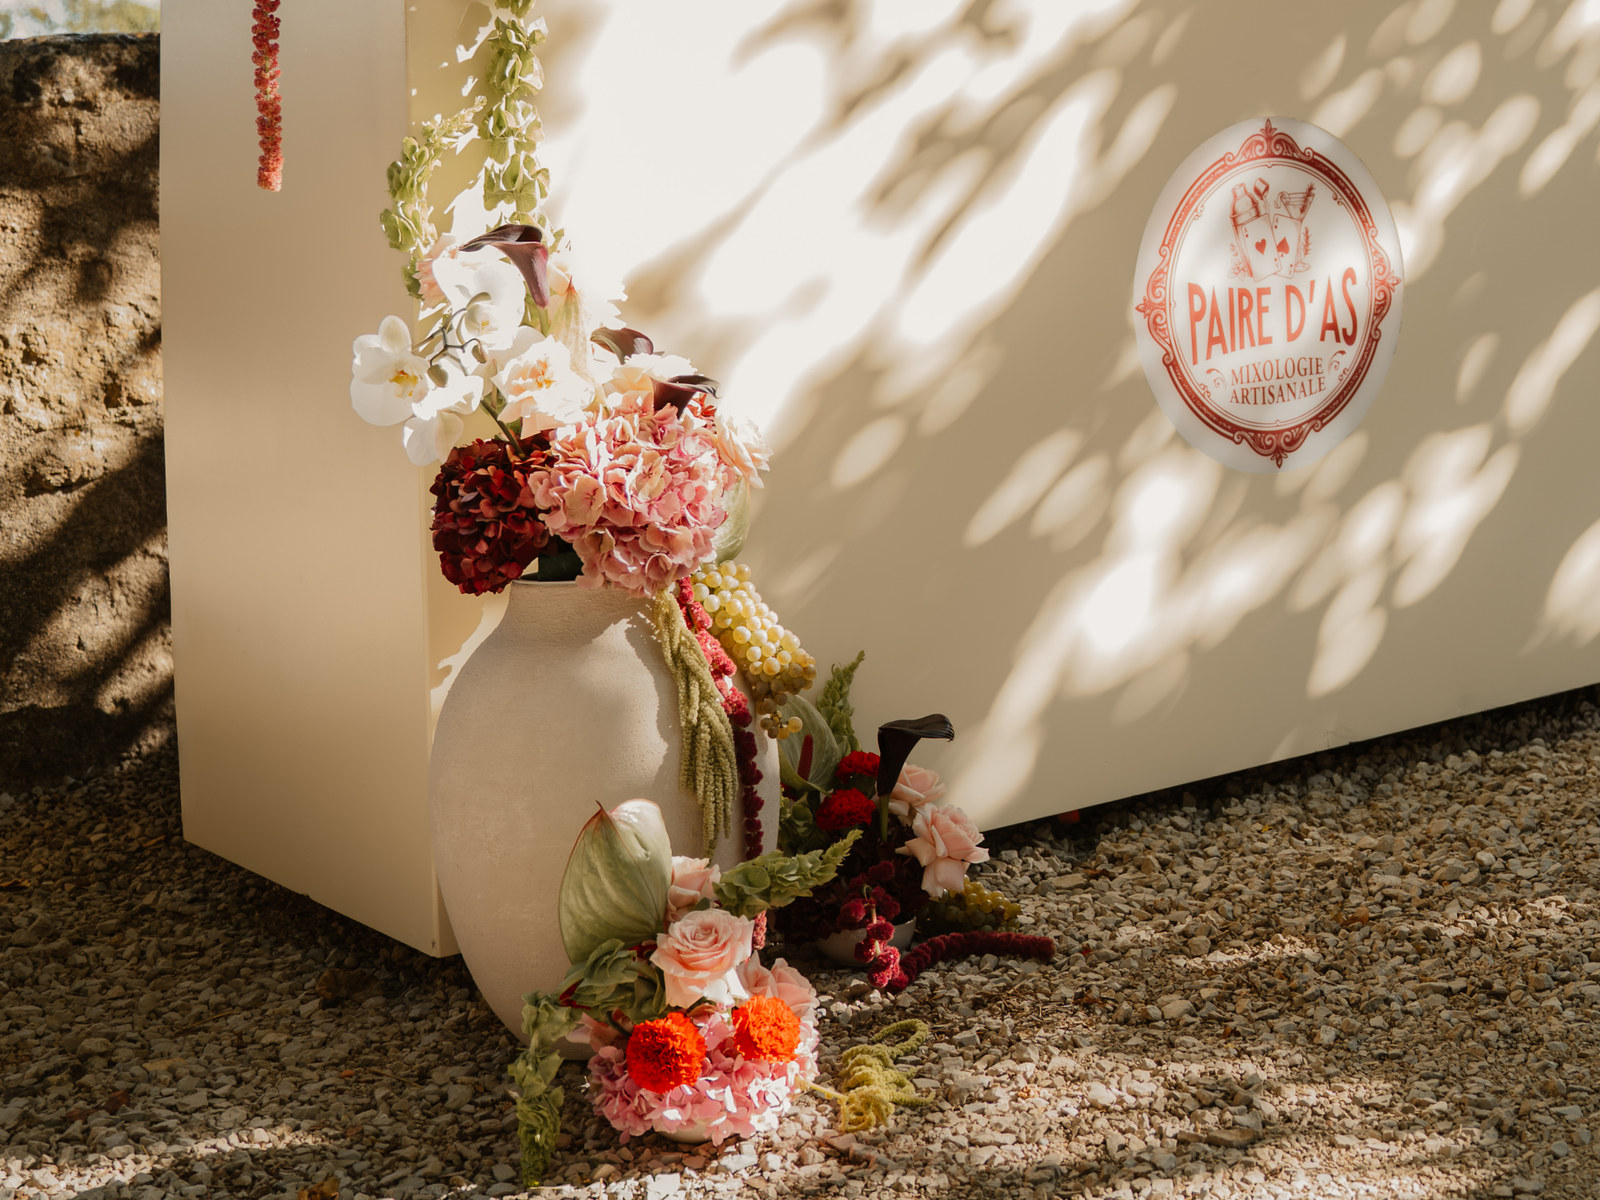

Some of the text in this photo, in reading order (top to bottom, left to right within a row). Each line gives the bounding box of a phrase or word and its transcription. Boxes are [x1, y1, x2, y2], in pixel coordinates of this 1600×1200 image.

[1187, 267, 1358, 365] PAIRE D'AS
[1231, 357, 1324, 386] MIXOLOGIE
[1230, 376, 1326, 405] ARTISANALE
